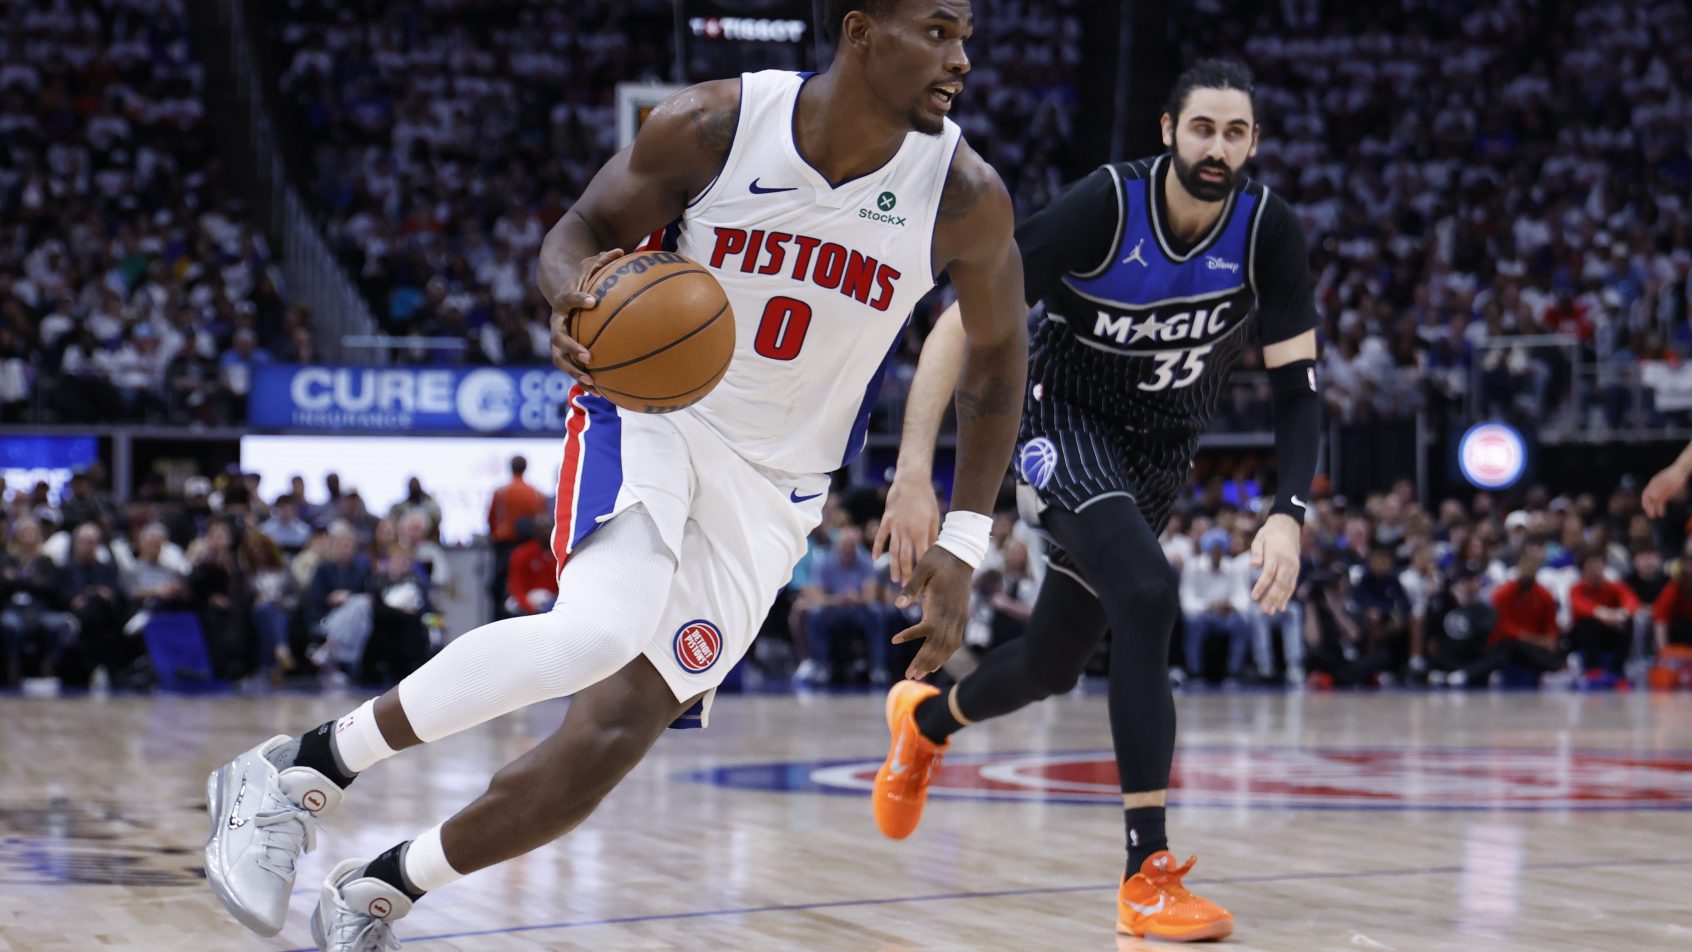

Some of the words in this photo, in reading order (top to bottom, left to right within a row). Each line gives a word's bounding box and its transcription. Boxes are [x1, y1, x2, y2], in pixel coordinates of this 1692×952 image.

[859, 208, 906, 227] StockX
[709, 227, 901, 312] PISTONS
[1206, 255, 1239, 273] Disney
[754, 295, 812, 361] 0
[1137, 345, 1213, 391] 35
[290, 367, 454, 413] CURE
[684, 634, 707, 664] PISTONS
[691, 629, 713, 659] DETROIT
